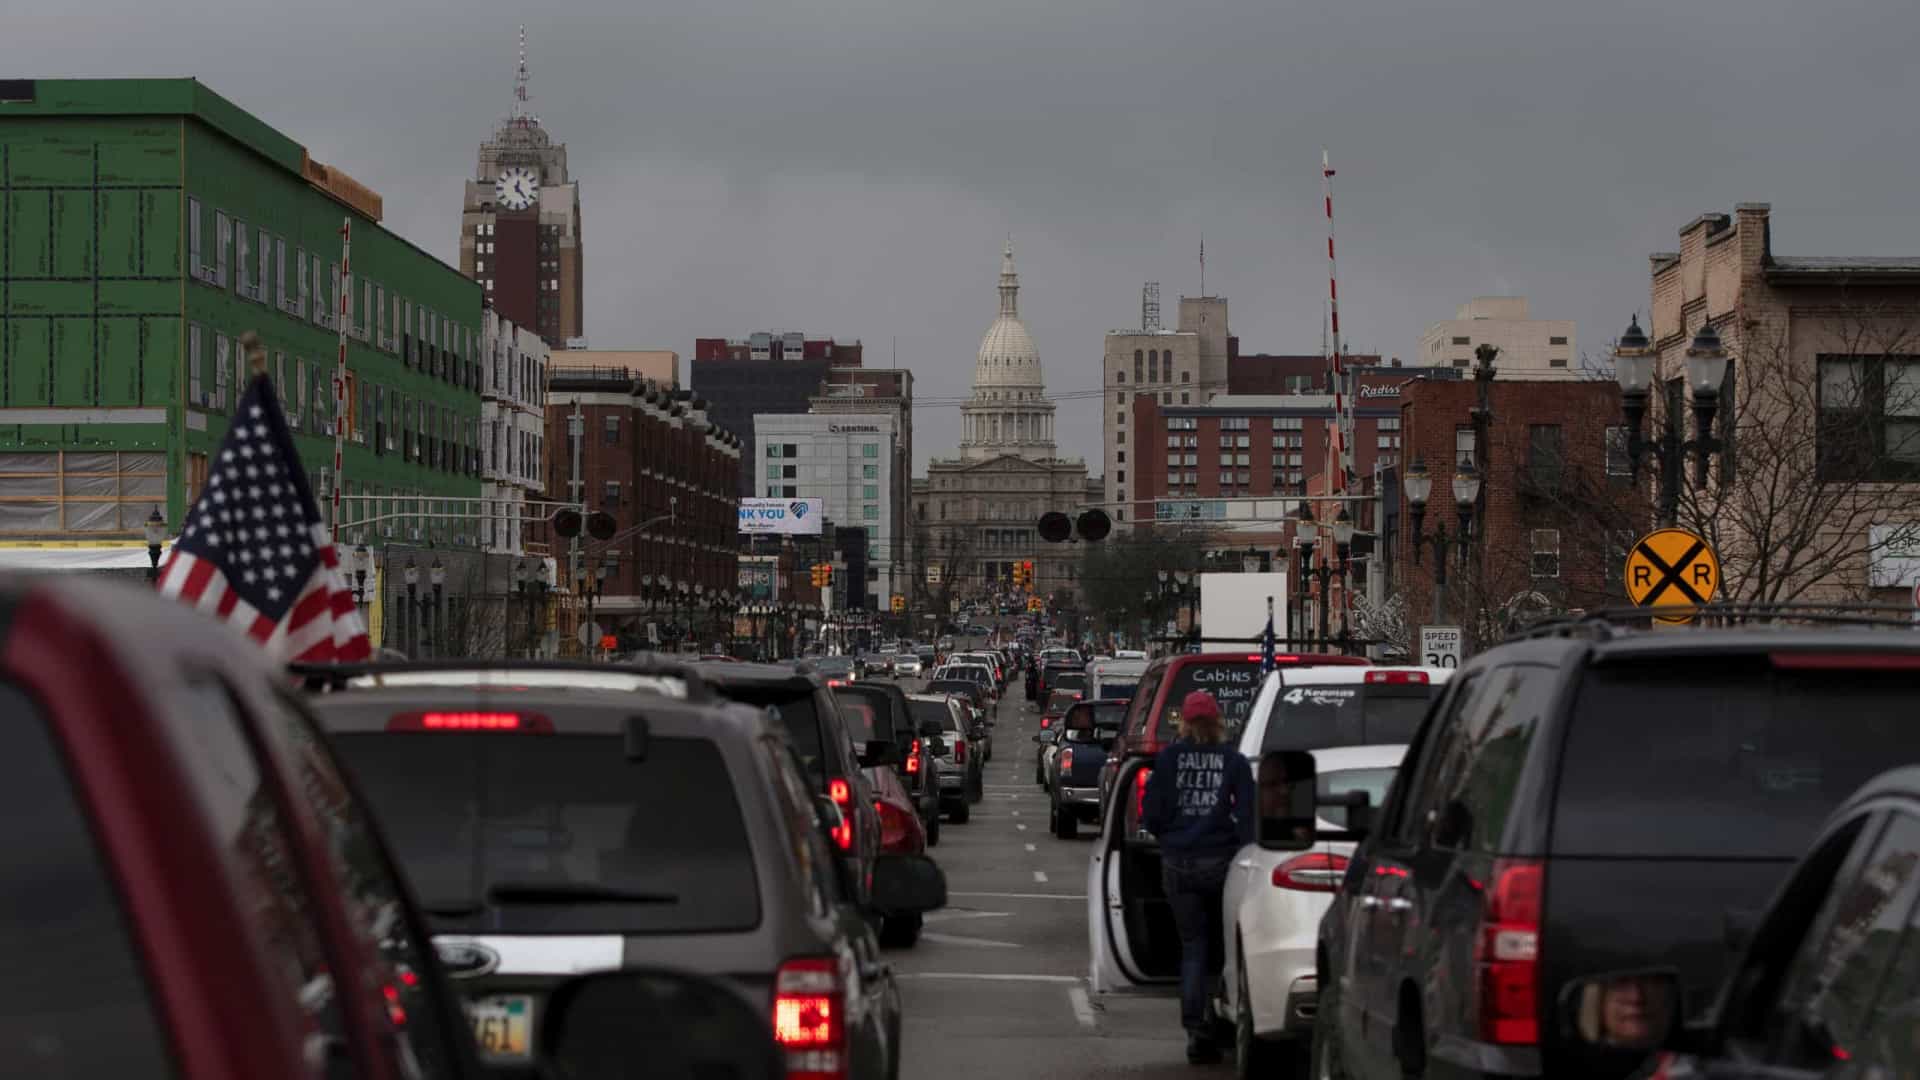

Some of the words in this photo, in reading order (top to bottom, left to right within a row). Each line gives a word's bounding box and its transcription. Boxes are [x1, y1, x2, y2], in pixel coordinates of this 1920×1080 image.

[758, 509, 785, 519] YOU
[1634, 566, 1651, 587] R
[1694, 563, 1711, 585] R
[1424, 632, 1457, 640] SPEED
[1427, 653, 1457, 668] 30
[1177, 752, 1224, 769] CALVIN
[1176, 770, 1223, 789] KLEIN
[1178, 789, 1219, 807] JEANS
